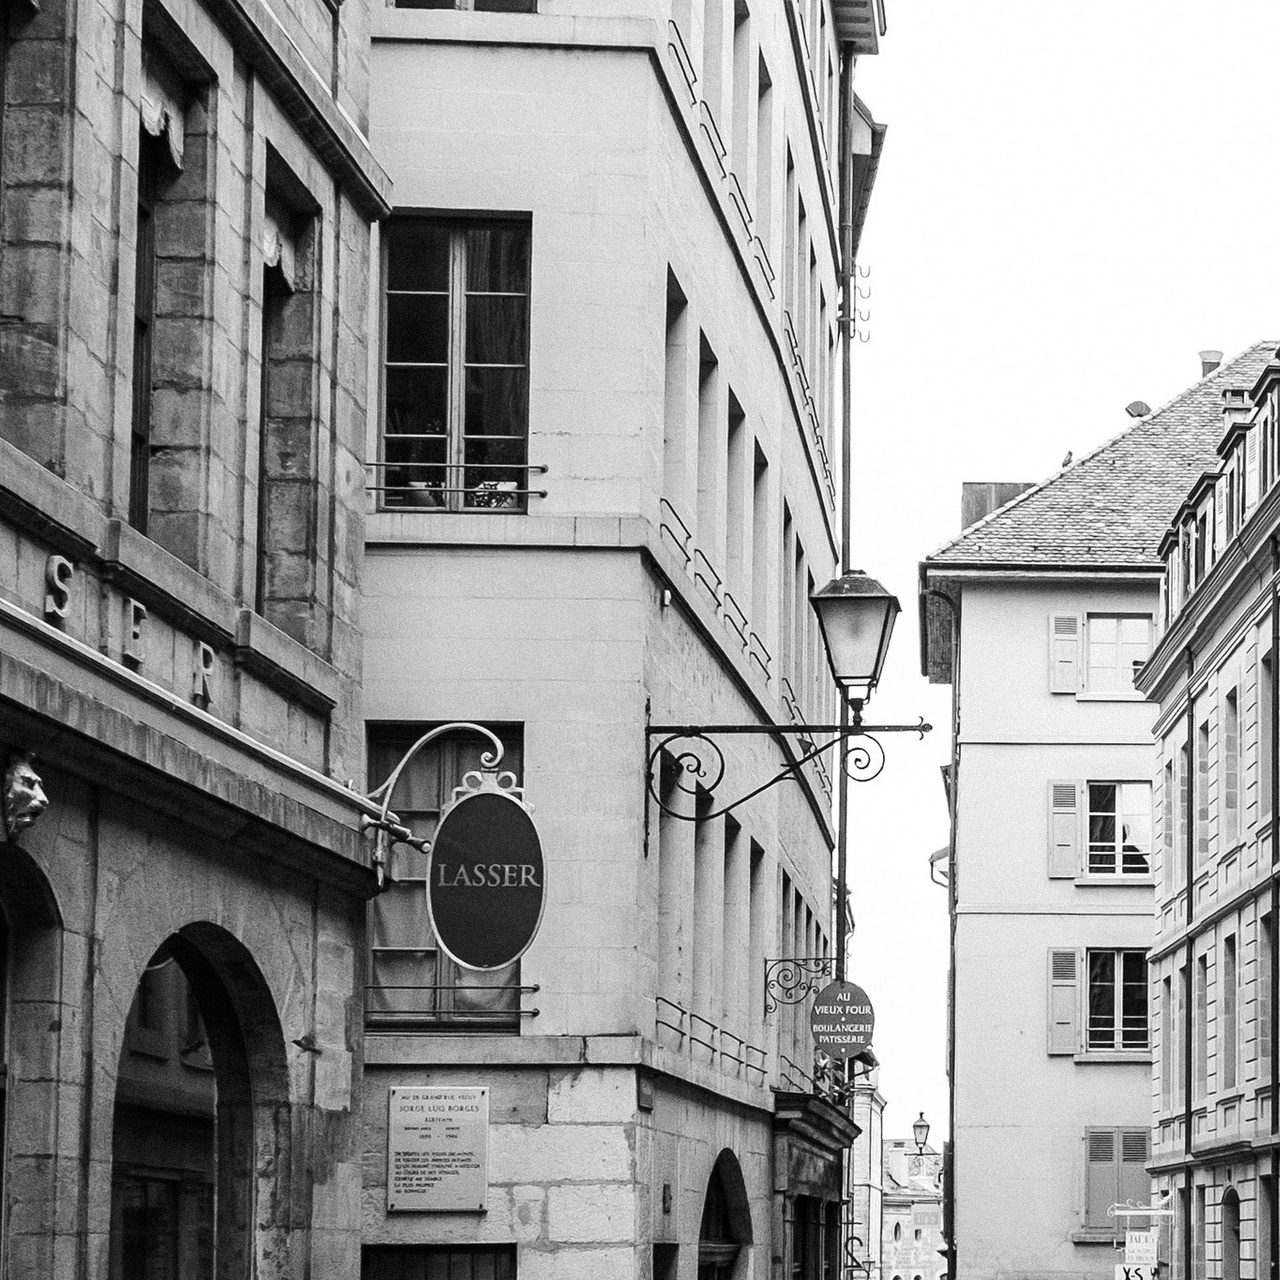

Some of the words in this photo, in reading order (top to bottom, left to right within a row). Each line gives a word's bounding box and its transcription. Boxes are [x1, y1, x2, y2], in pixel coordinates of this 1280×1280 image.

[437, 863, 542, 888] LASSER
[836, 992, 851, 1002] AU
[814, 1005, 844, 1015] VIEUX
[845, 1005, 872, 1015] FOUR
[812, 1023, 873, 1033] BOULANGERIE
[819, 1035, 866, 1044] PATISSERIE
